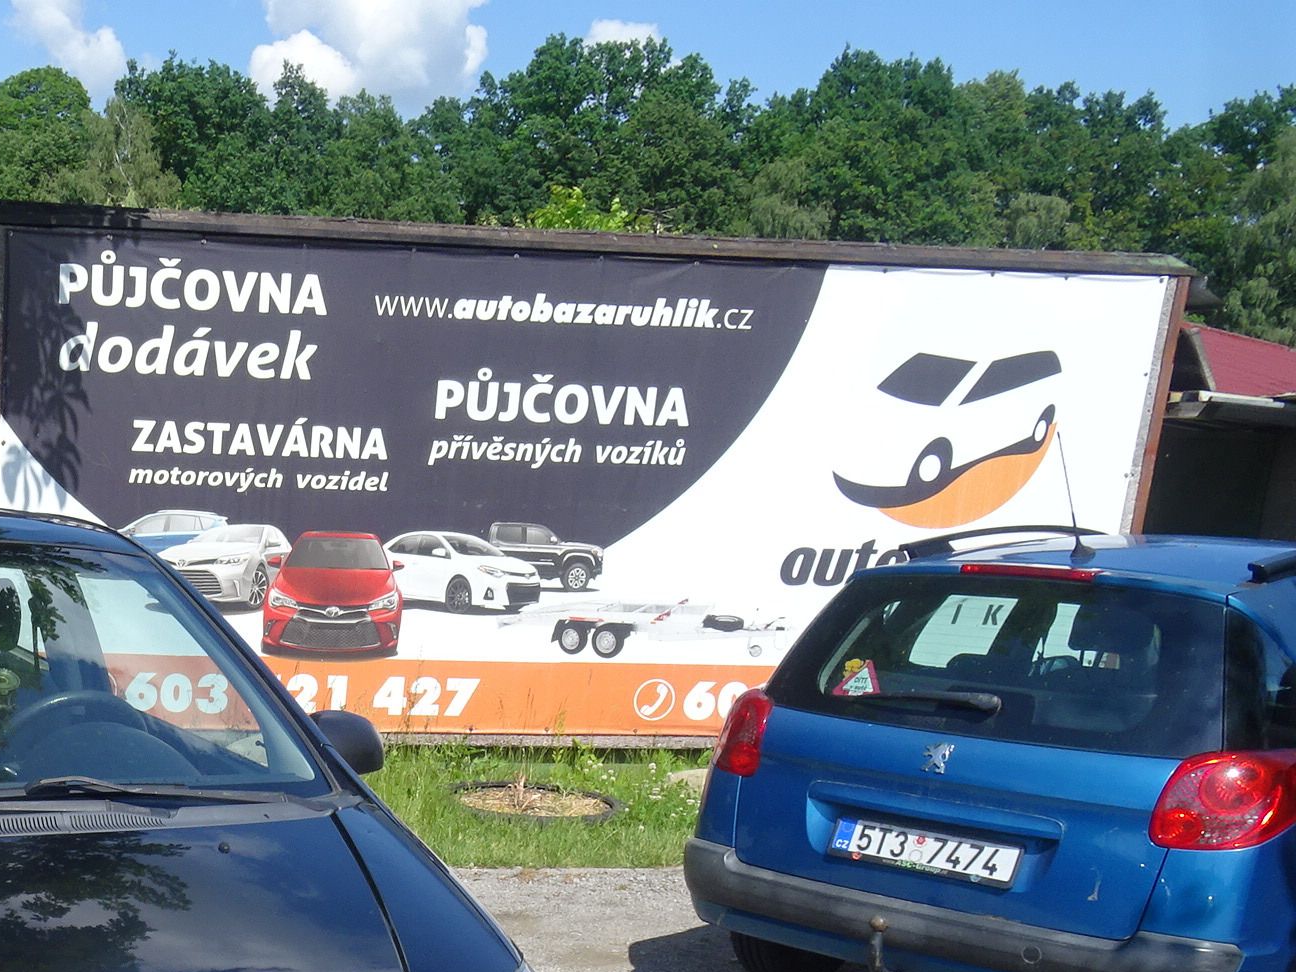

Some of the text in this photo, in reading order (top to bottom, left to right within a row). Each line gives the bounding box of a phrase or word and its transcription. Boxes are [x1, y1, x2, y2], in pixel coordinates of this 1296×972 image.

[58, 249, 328, 316] PŮJČOVNA
[374, 293, 755, 330] www.autobazaruhlik.cz
[58, 321, 319, 380] dodávek
[434, 367, 690, 428] PŮJČOVNA
[131, 417, 389, 460] ZASTAVÁRNA
[427, 434, 687, 469] přívěsných vozíků
[128, 467, 389, 493] motorových vozidel
[124, 672, 481, 717] 603 21 427
[835, 838, 849, 849] CZ
[856, 825, 1000, 876] 5T3 7474
